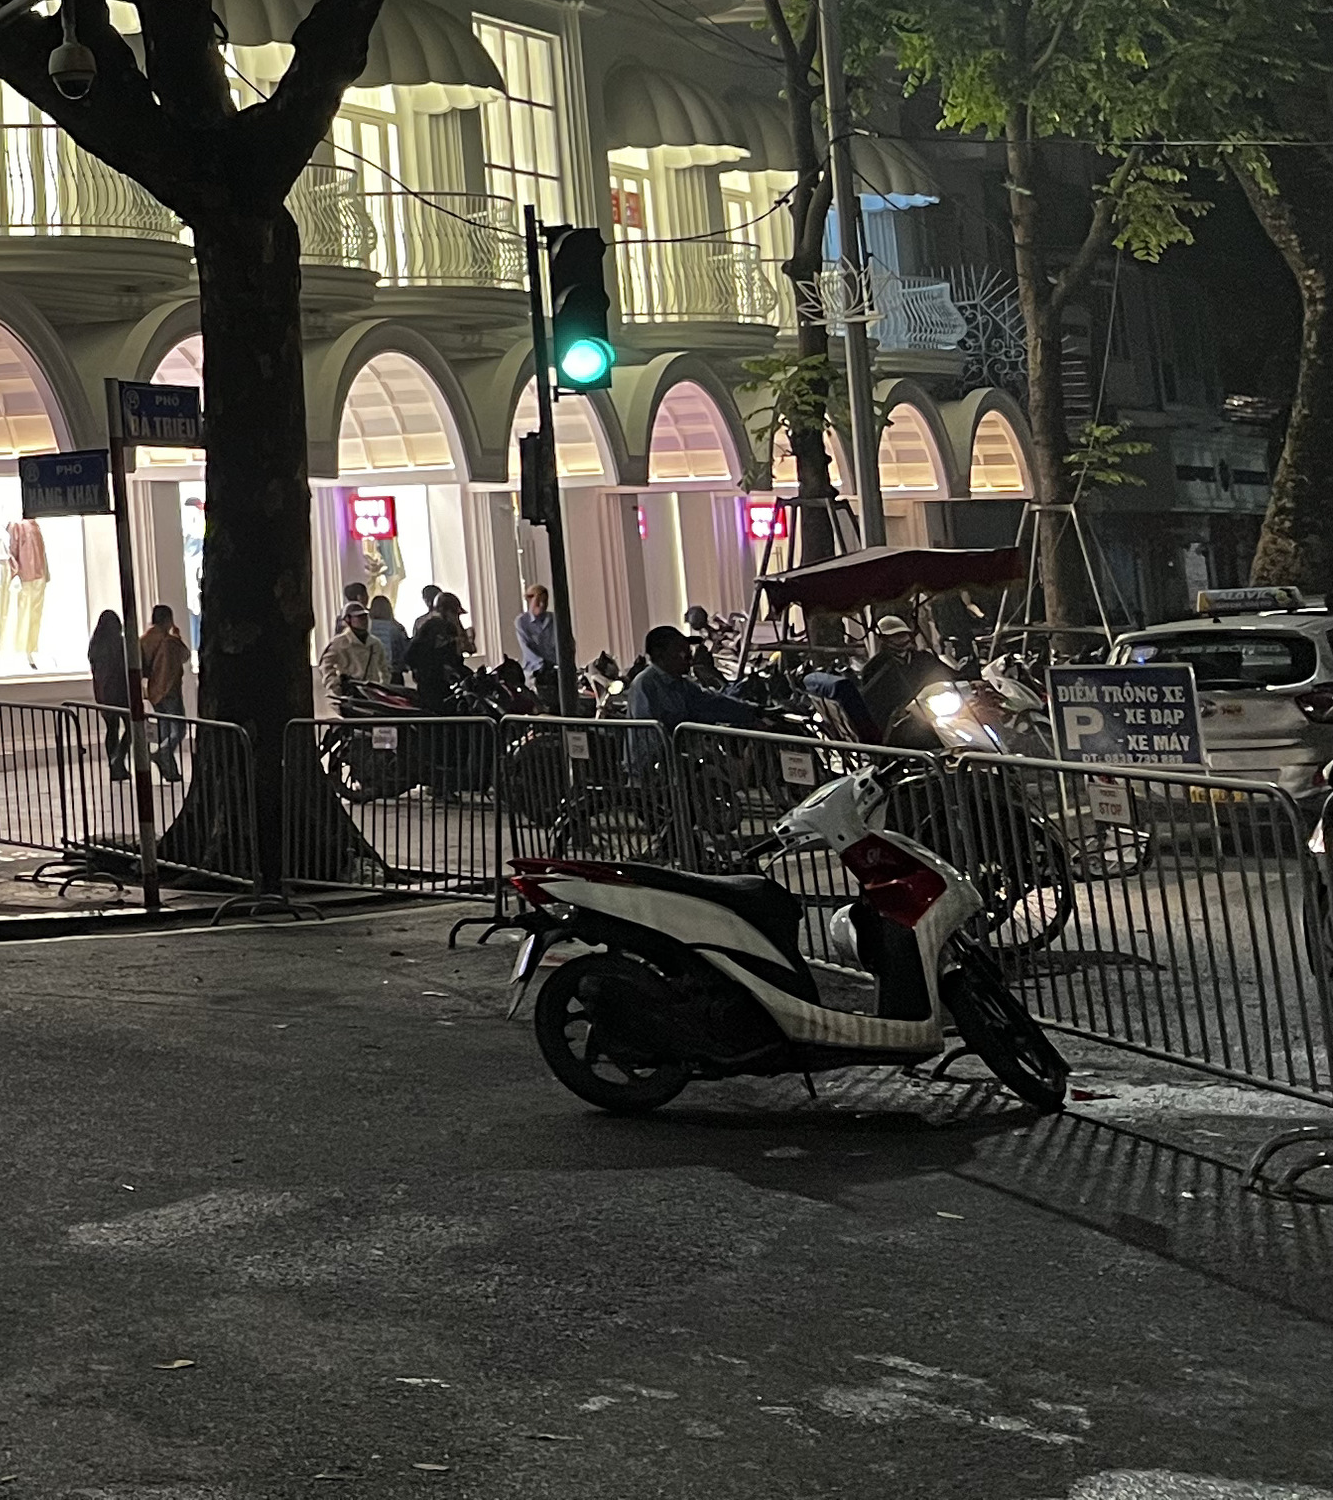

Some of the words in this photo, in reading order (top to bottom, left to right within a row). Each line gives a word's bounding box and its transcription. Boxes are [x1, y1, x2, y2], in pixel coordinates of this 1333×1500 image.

[1056, 676, 1099, 703] ĐIỂM
[1101, 680, 1158, 703] TRÔNG
[1162, 685, 1186, 703] XE
[1062, 706, 1104, 750] P
[1124, 708, 1146, 725] XE
[1150, 708, 1185, 729] ĐẠP
[1127, 734, 1149, 751] XE
[1153, 732, 1191, 752] MÁY
[1098, 802, 1123, 816] STOP
